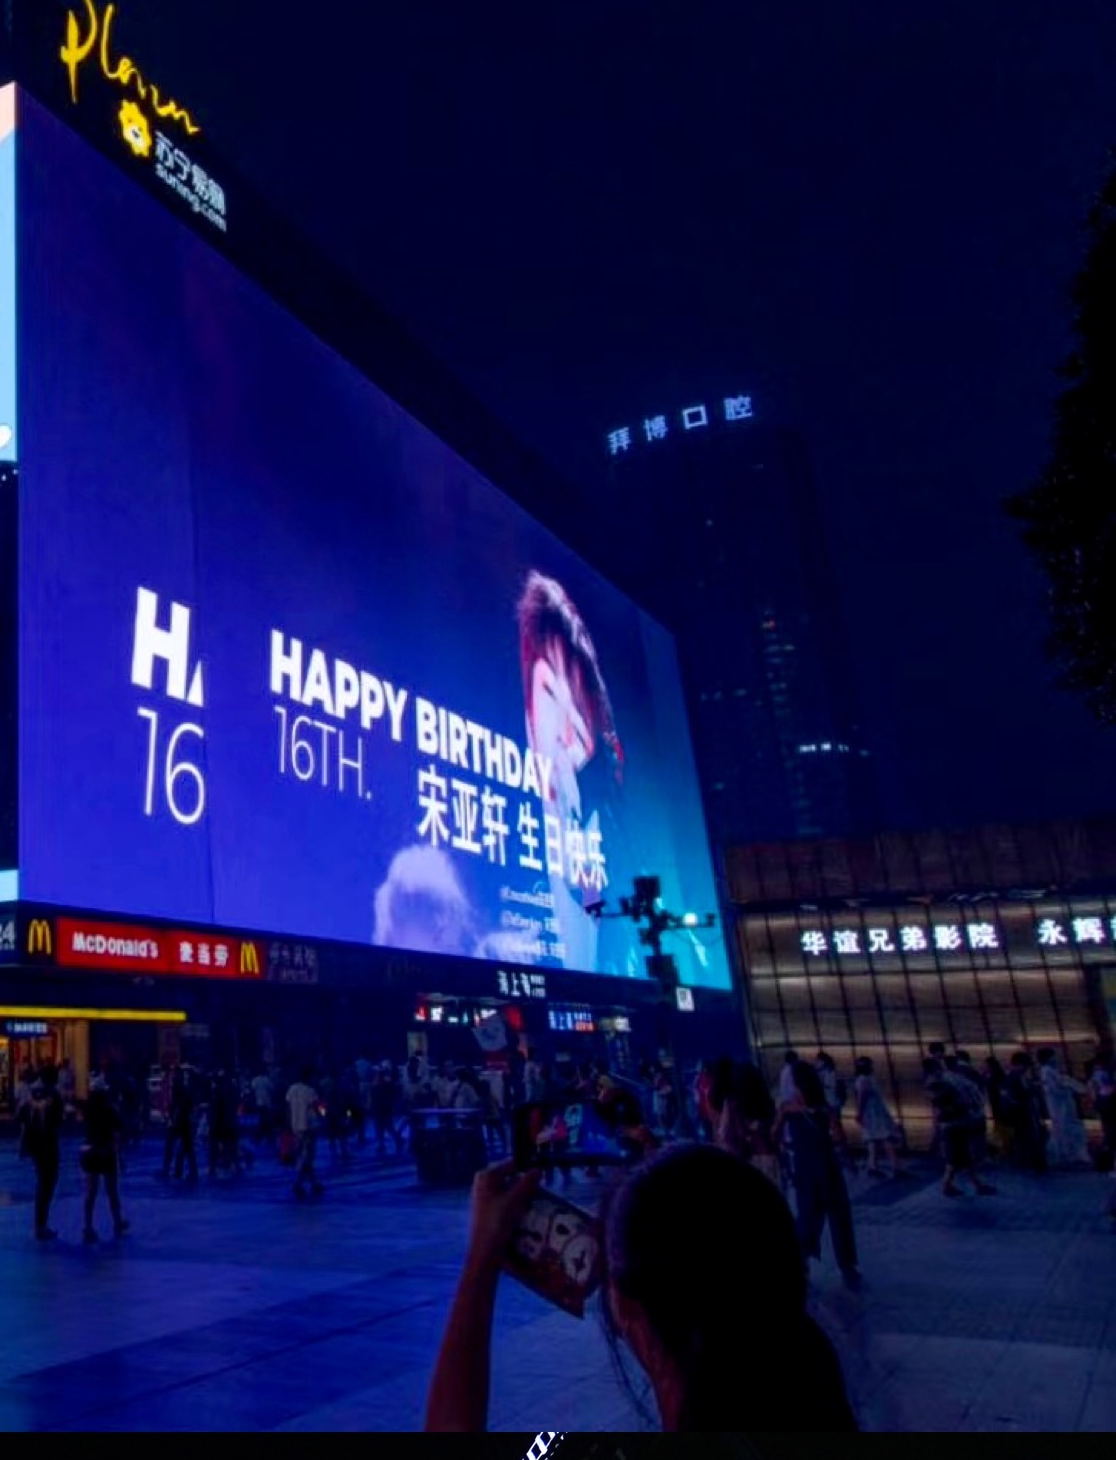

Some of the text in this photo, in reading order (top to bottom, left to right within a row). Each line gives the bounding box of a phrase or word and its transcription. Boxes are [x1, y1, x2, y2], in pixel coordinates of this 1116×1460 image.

[607, 395, 752, 454] 拜博口腔
[269, 628, 556, 802] HAPPY BIRTHDAY
[273, 706, 372, 801] 16TH.
[416, 765, 610, 893] 宋亚轩 生日快乐
[72, 931, 159, 960] McDonald's
[179, 942, 229, 967] 麦当劳
[801, 923, 999, 956] 华谊兄弟影院
[1038, 917, 1116, 946] 永辉
